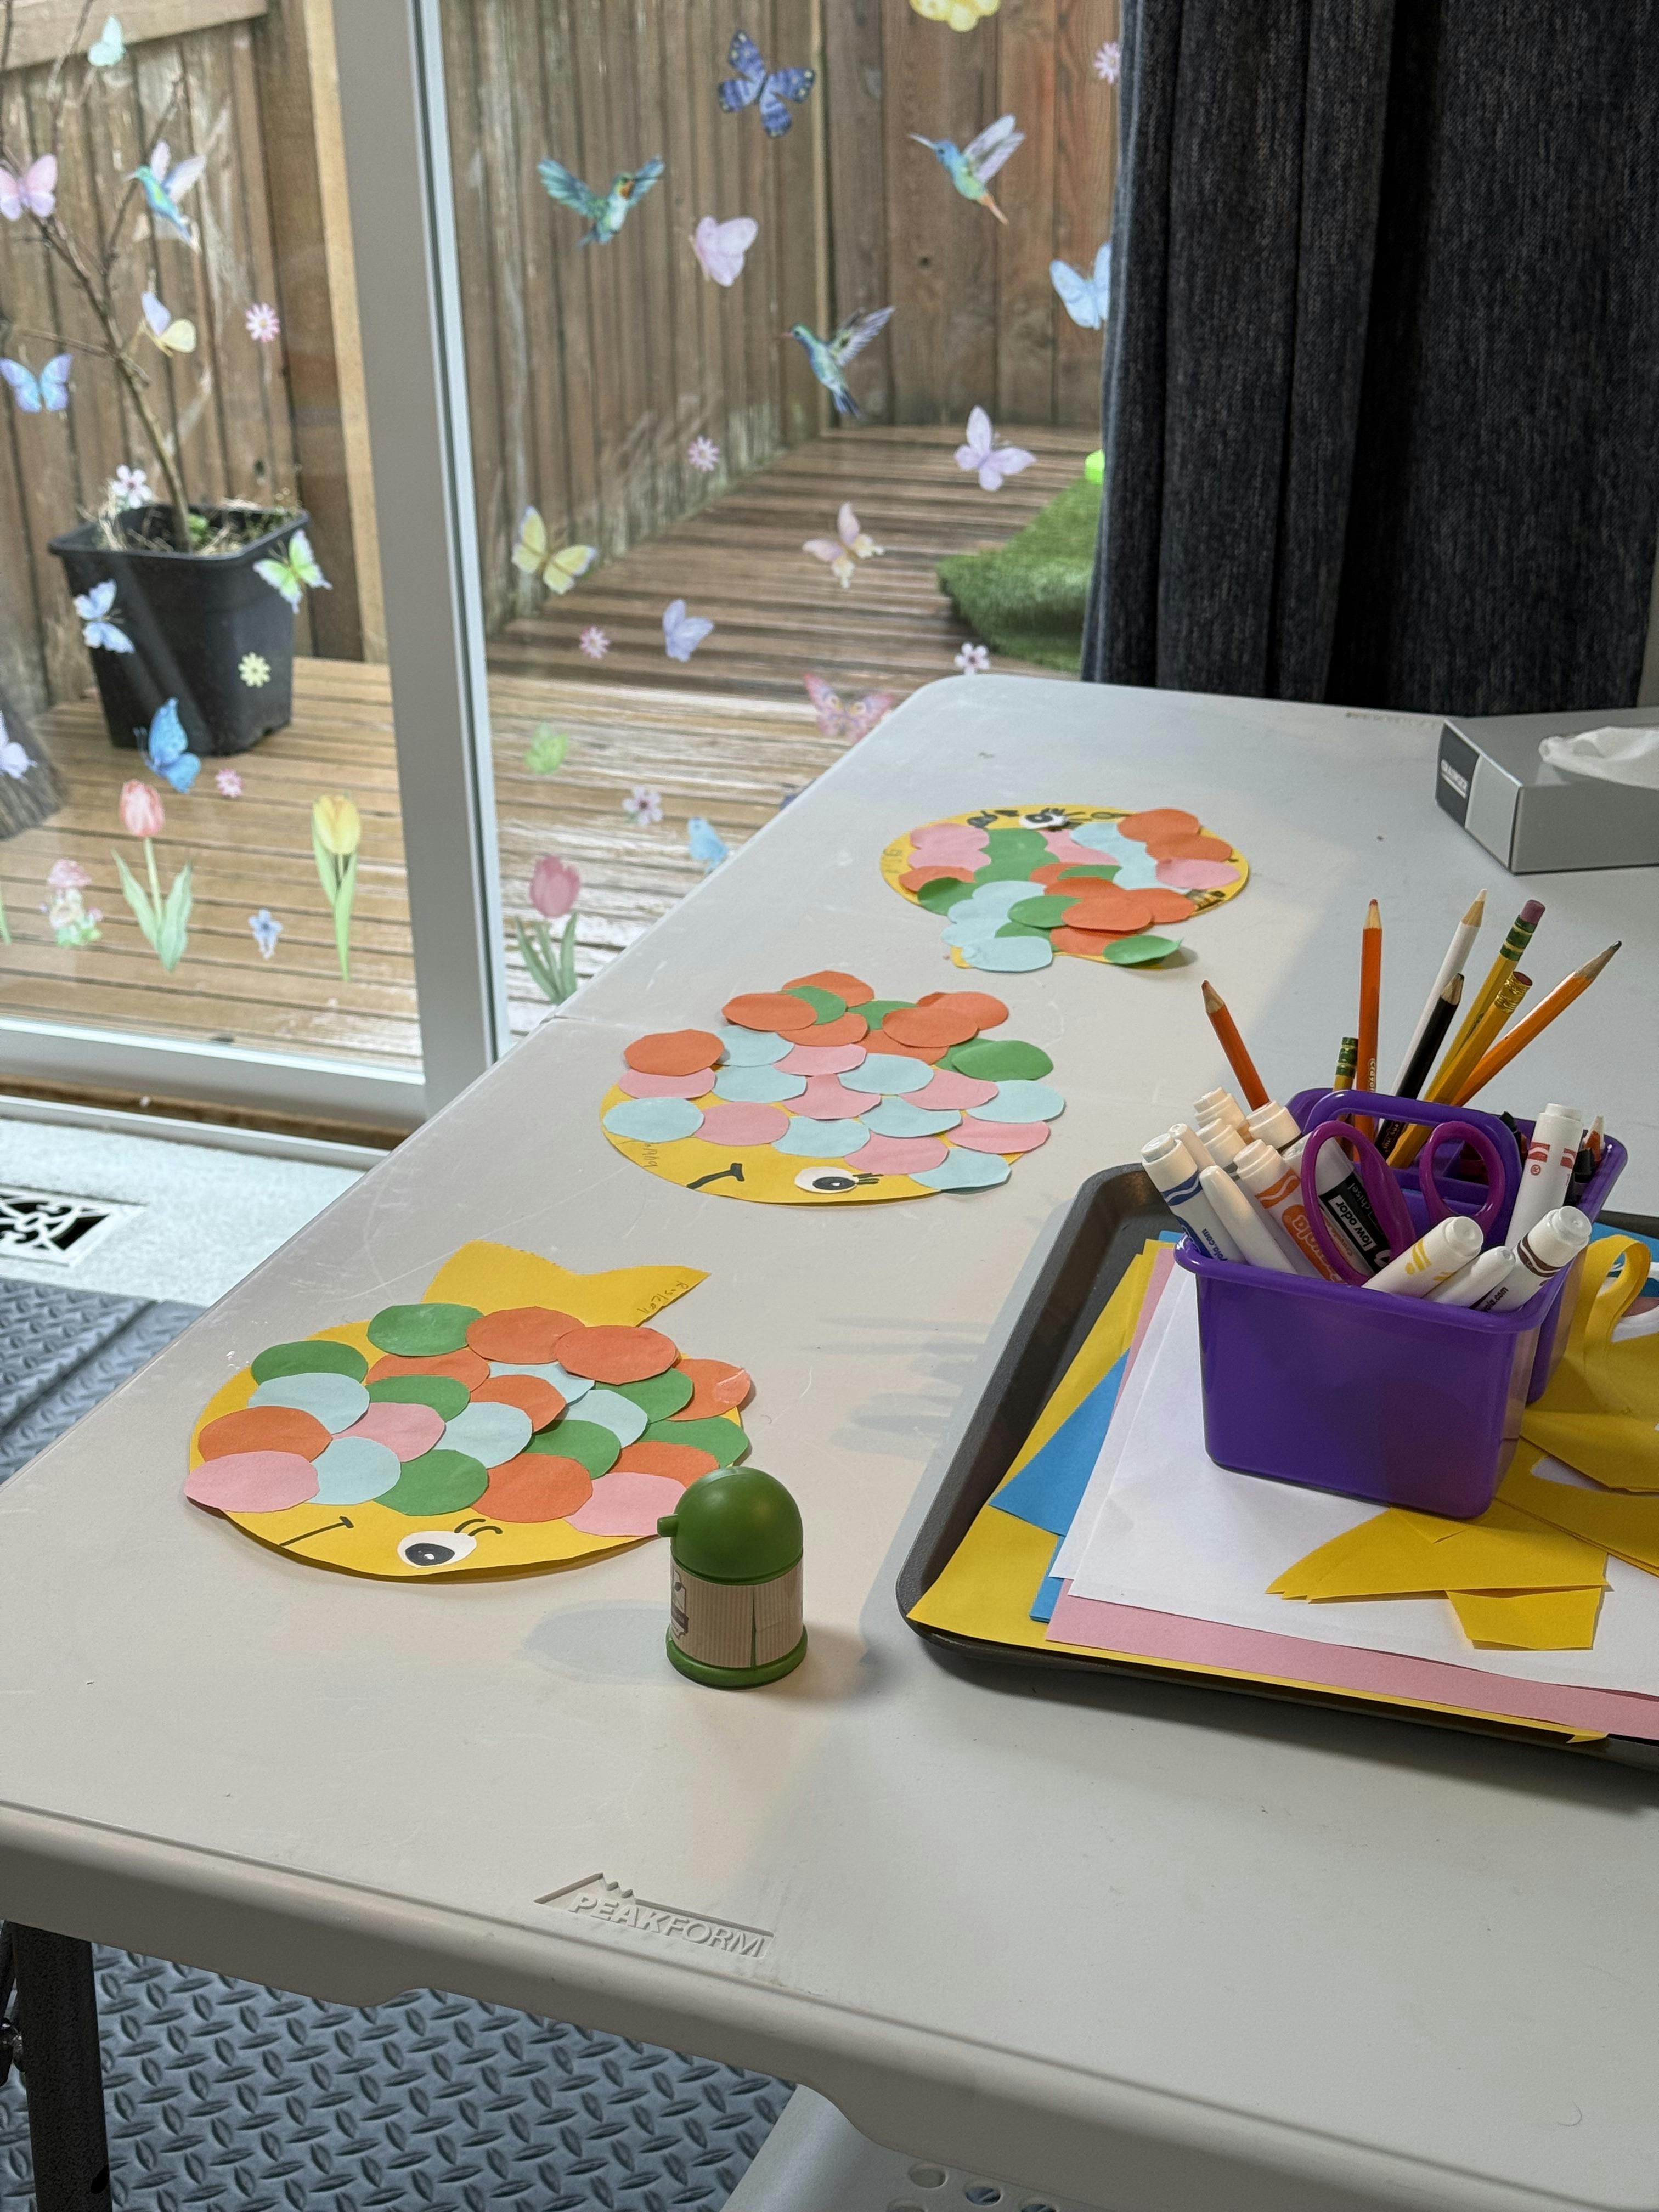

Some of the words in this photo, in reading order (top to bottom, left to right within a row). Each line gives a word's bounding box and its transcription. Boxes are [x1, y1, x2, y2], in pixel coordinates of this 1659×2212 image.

[1347, 1183, 1370, 1210] chisel
[1336, 1201, 1357, 1226] odor
[1355, 1227, 1373, 1248] low
[568, 1893, 765, 1958] PEAKFORM
